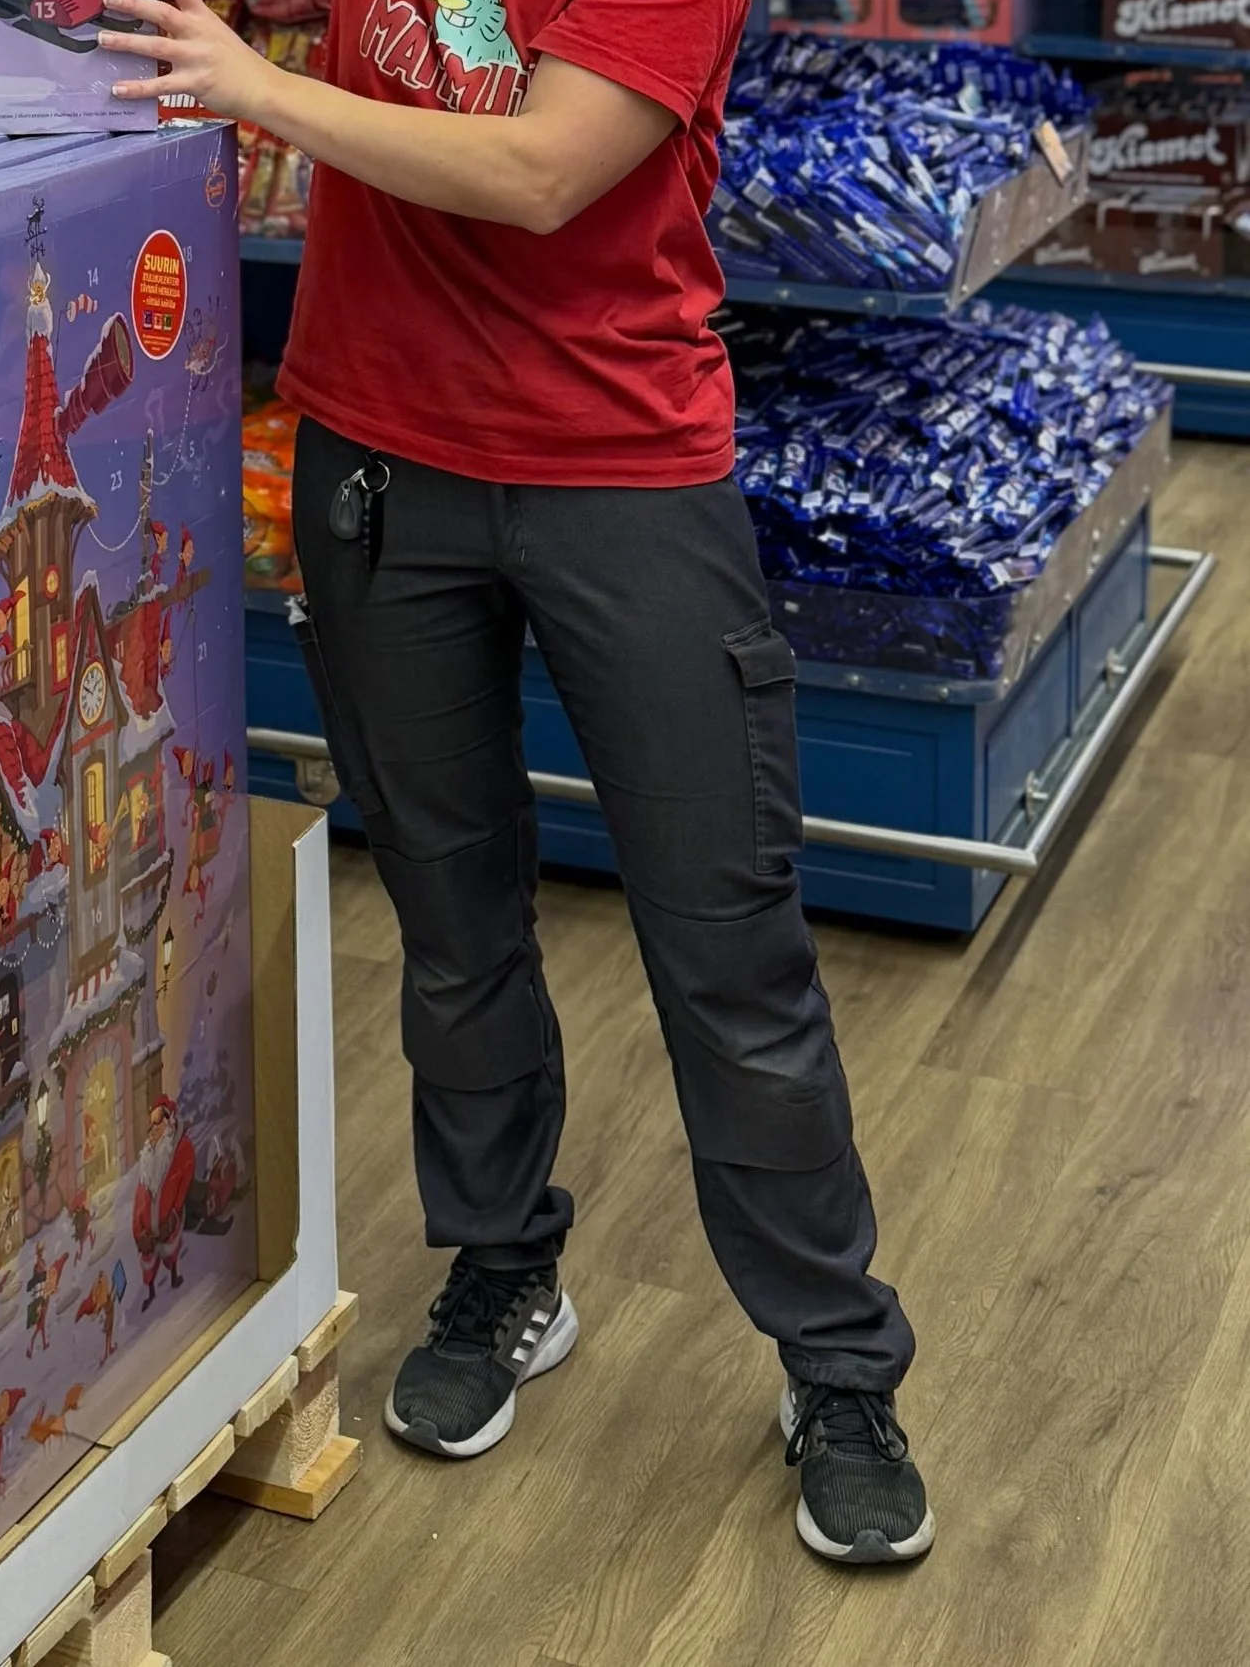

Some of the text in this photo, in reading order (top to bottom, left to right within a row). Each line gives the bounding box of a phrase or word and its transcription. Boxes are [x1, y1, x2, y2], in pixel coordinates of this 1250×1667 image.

[34, 1, 56, 19] 13
[144, 254, 179, 275] SUURIN
[87, 267, 99, 287] 14
[189, 441, 195, 458] 5
[111, 470, 123, 491] 23
[115, 641, 125, 659] 11
[198, 642, 207, 662] 21
[92, 908, 102, 926] 16
[5, 1235, 13, 1253] 6
